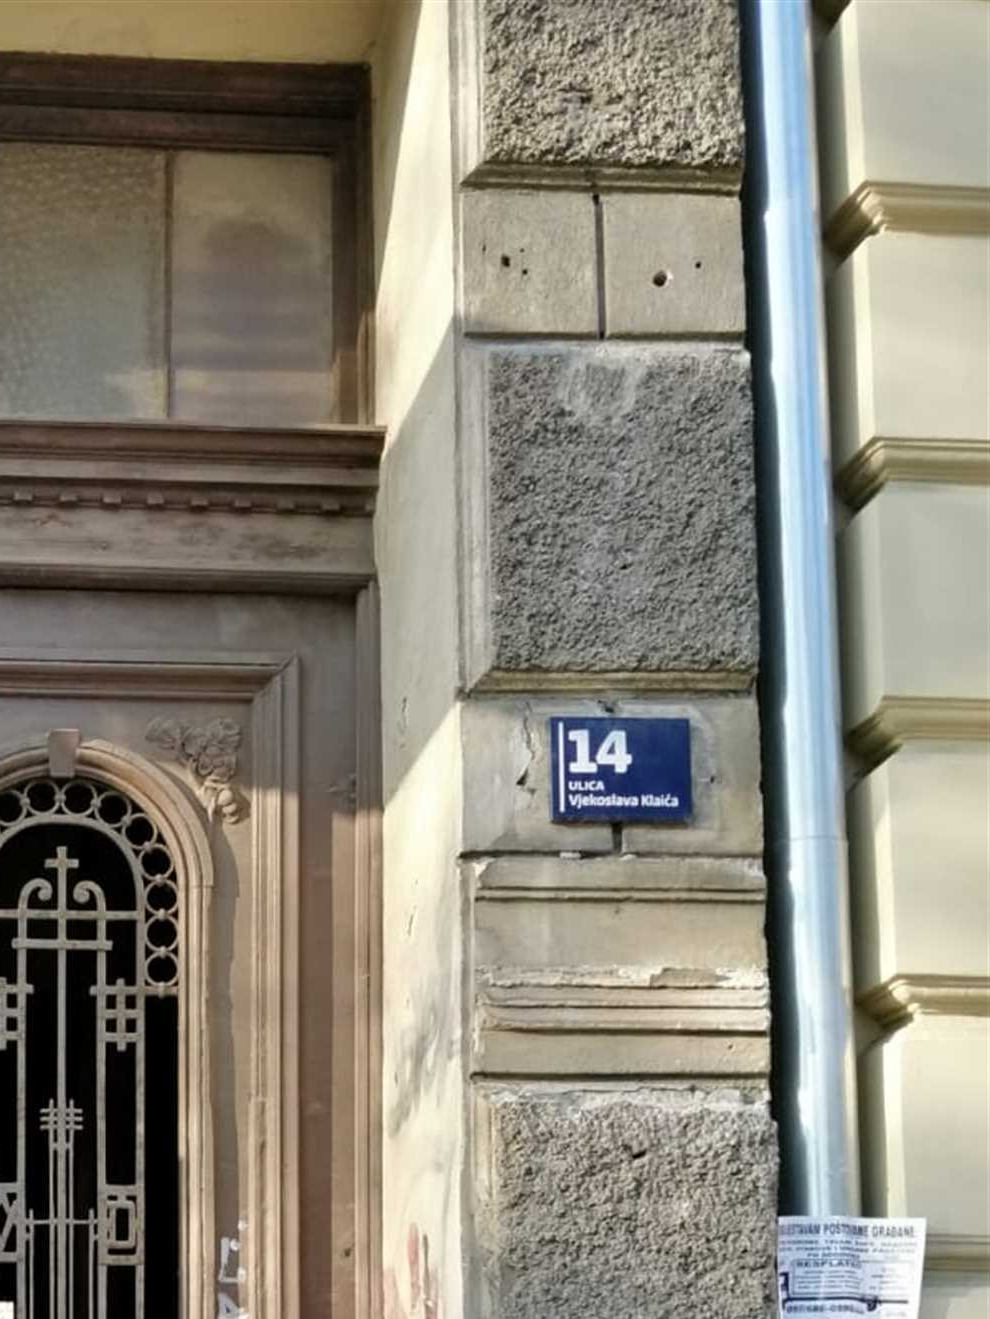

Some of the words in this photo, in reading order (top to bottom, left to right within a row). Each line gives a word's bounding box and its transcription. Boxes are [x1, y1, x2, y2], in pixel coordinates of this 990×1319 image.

[568, 729, 633, 774] 14
[568, 780, 605, 791] ULICA
[568, 793, 639, 809] Vjekoslava
[641, 793, 680, 807] Klaića
